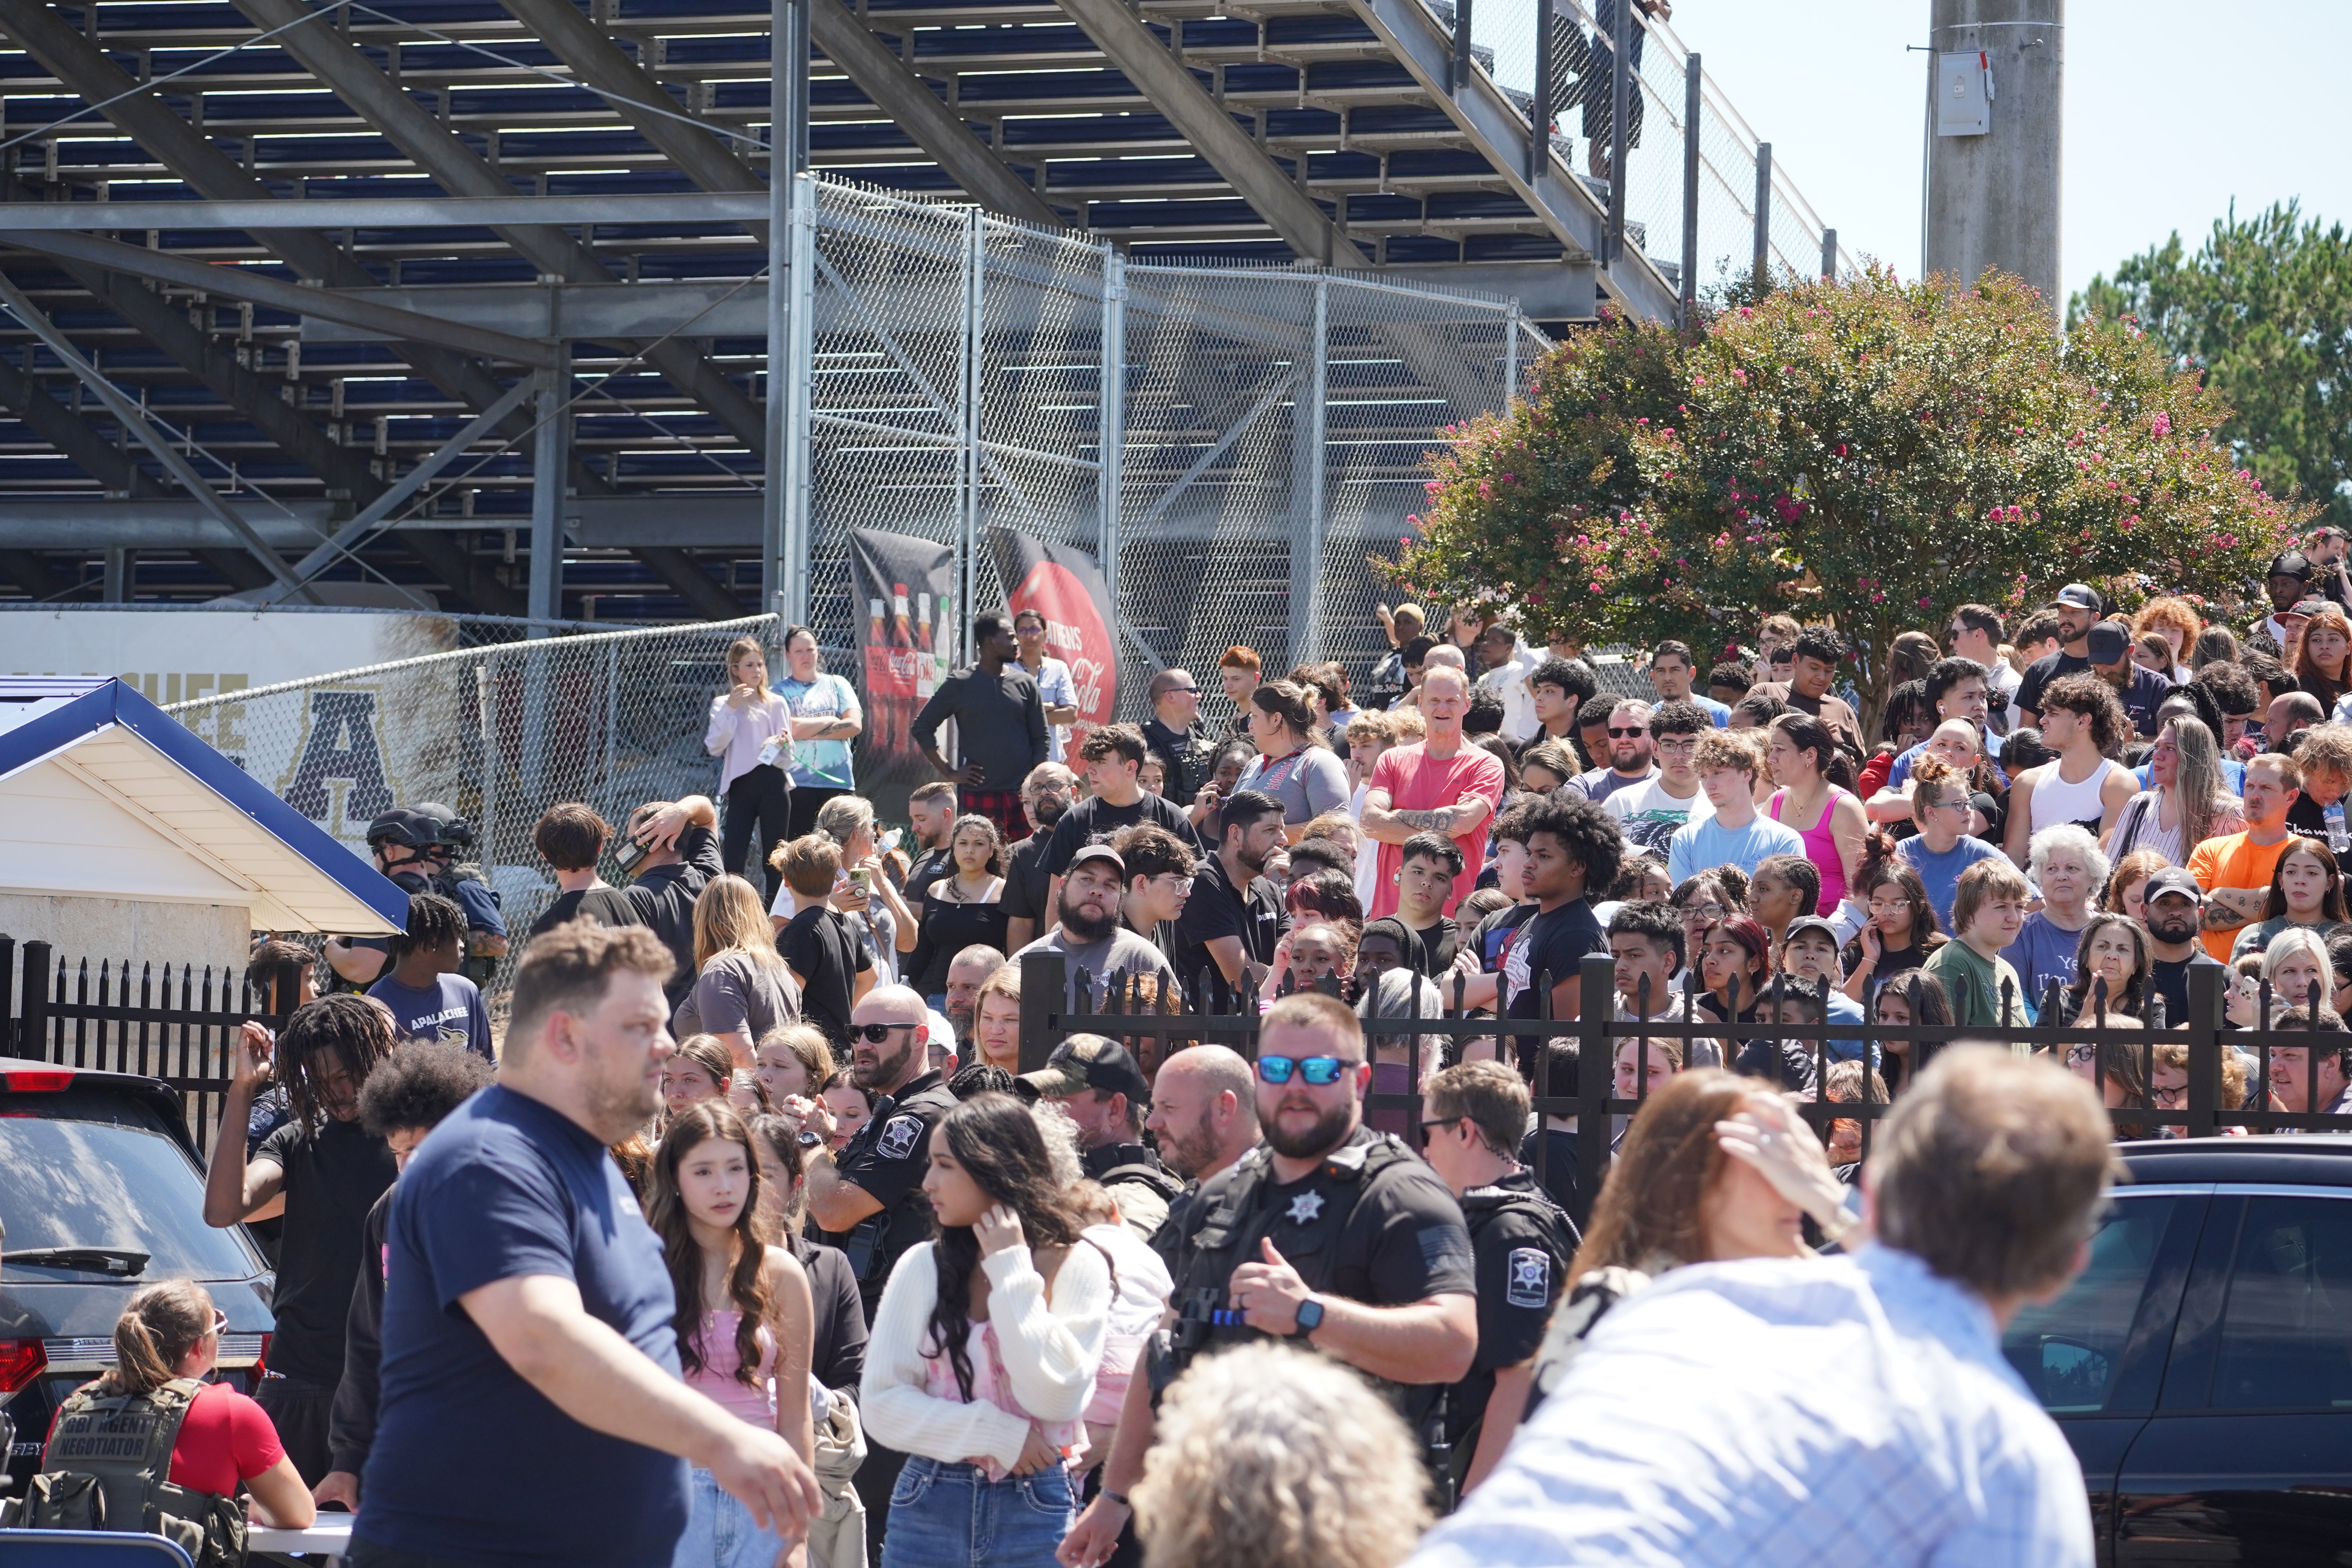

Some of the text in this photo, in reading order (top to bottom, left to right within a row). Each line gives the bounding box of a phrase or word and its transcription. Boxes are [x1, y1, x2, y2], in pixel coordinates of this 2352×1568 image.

[1045, 620, 1082, 652] ATHENS
[1267, 761, 1295, 790] GEORGIA
[2058, 955, 2078, 971] Ye
[412, 1006, 468, 1031] APALACHEE
[258, 1103, 272, 1113] POLICE
[65, 1416, 147, 1434] GBI AGENT
[59, 1437, 145, 1456] NEGOTIATOR
